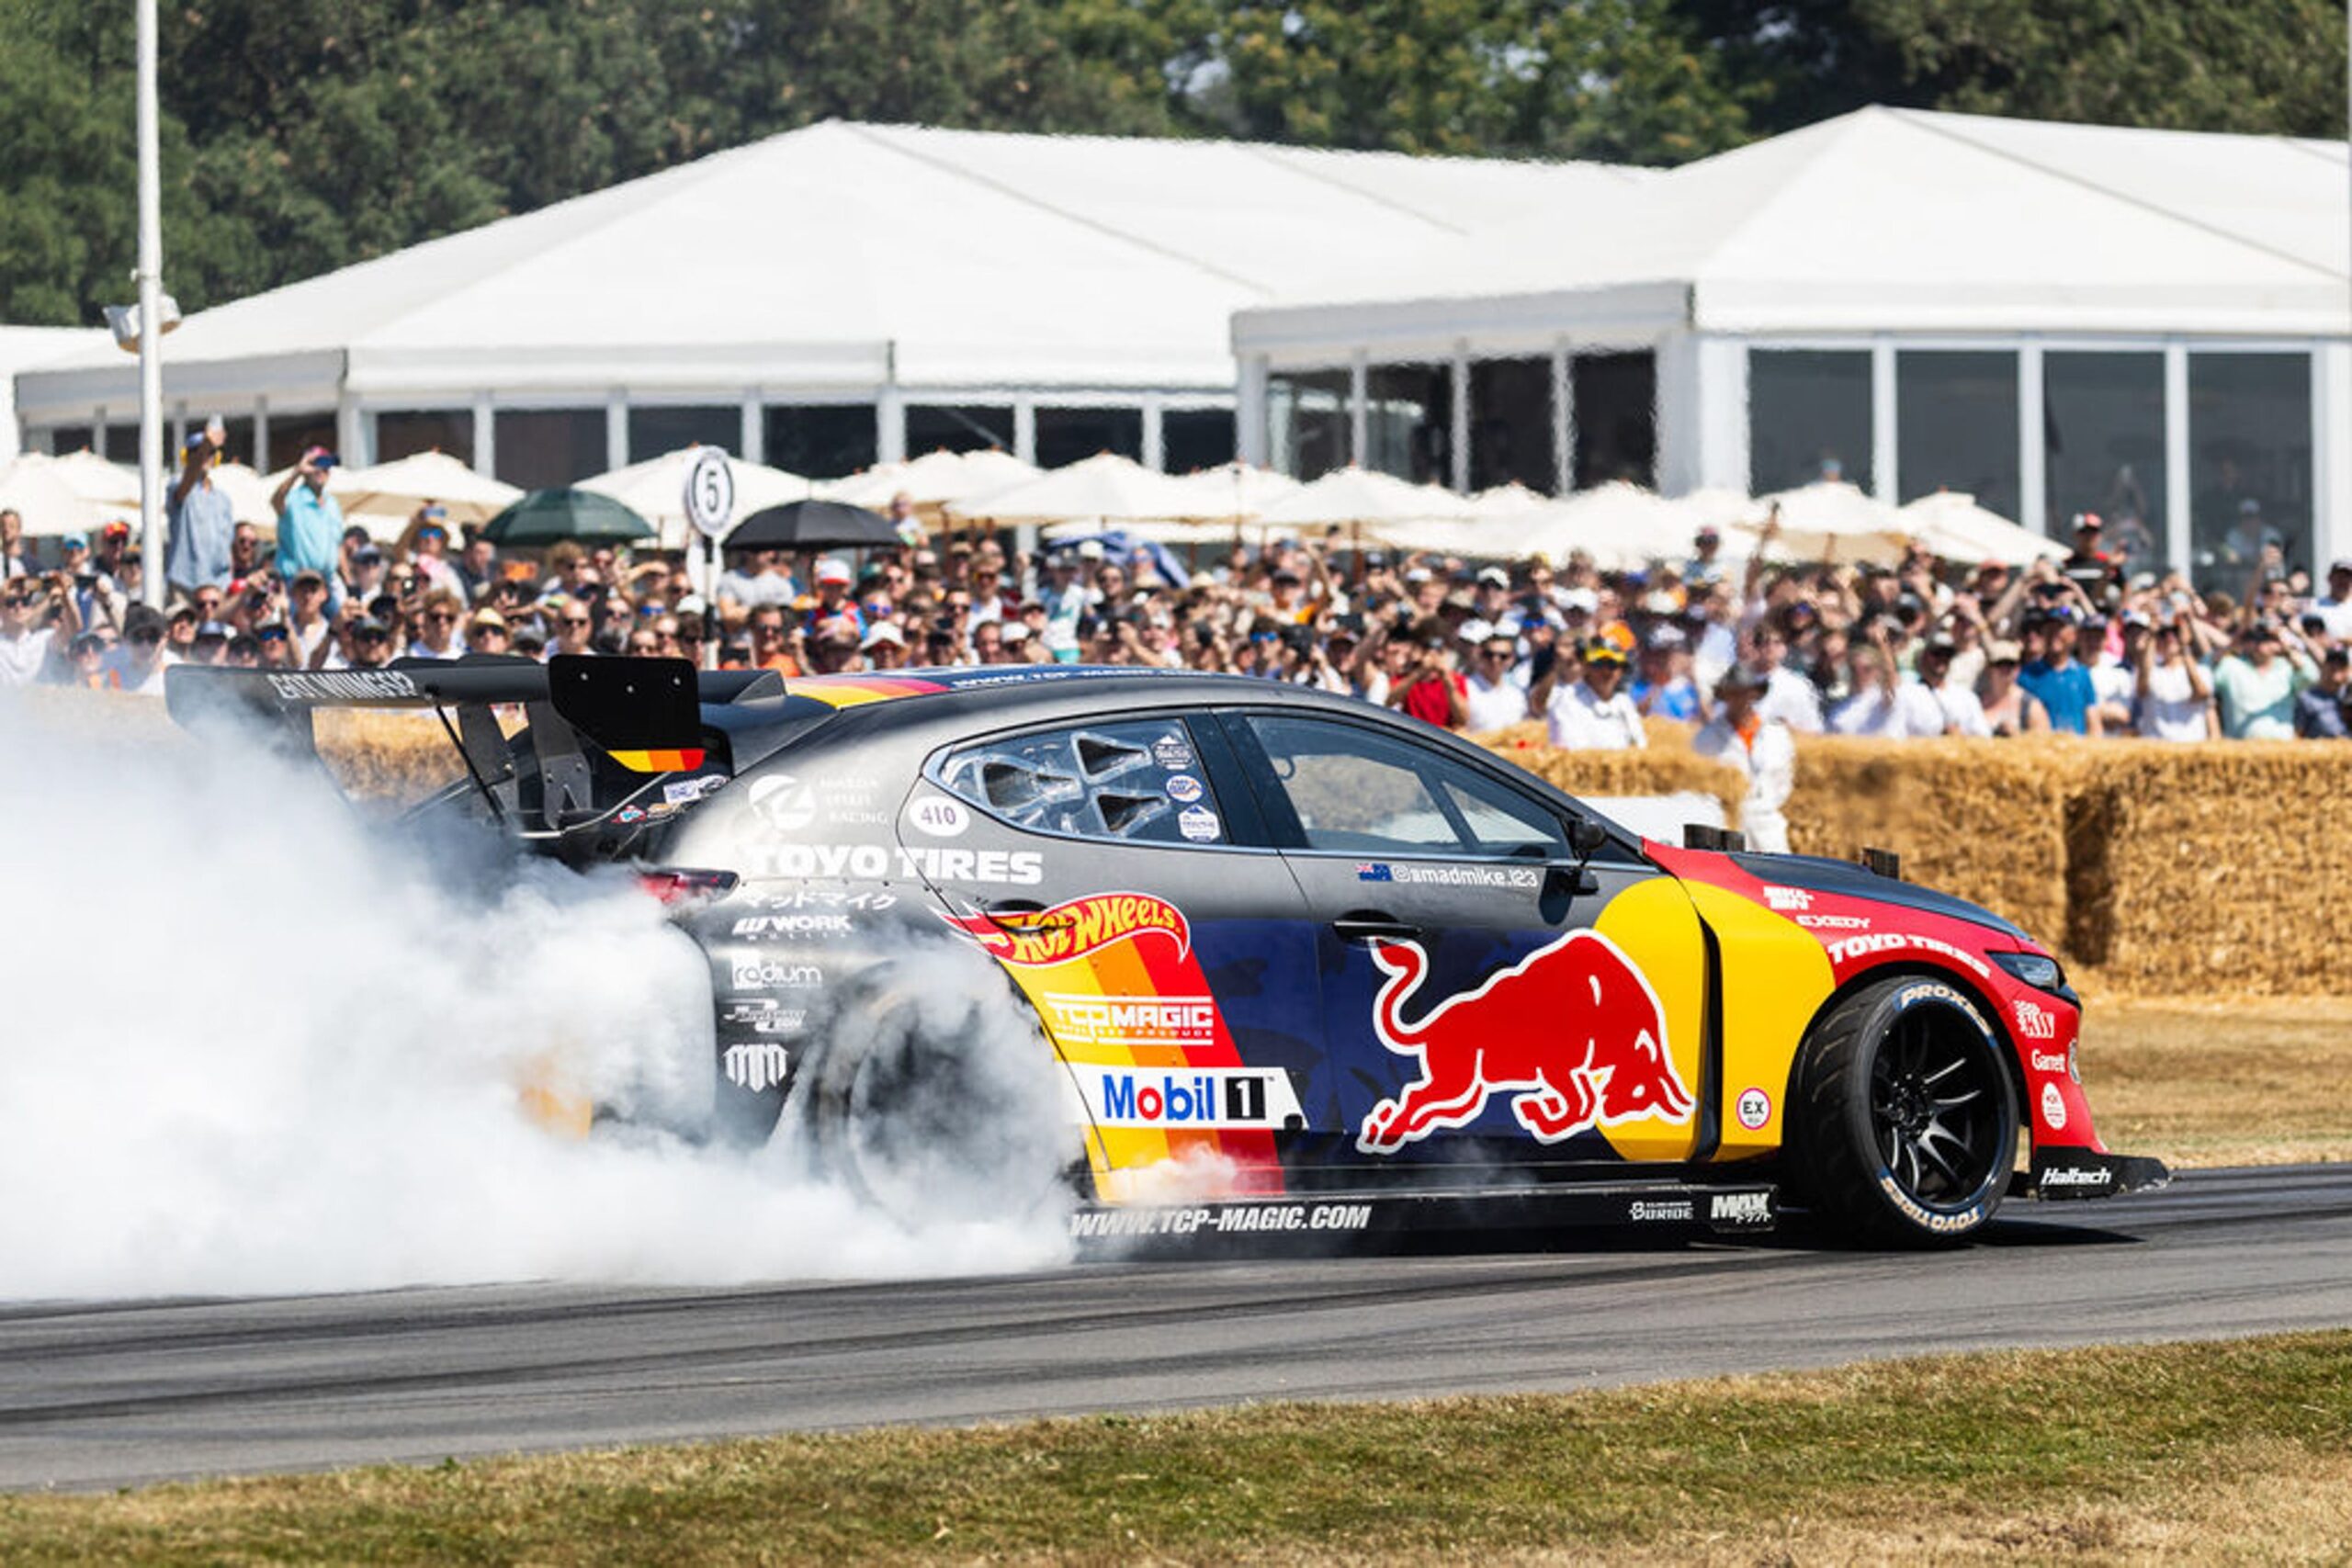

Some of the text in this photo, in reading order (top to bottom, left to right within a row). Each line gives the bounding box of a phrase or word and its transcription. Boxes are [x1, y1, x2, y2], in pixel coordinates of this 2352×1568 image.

[707, 469, 718, 513] 5
[920, 806, 957, 827] 410
[744, 844, 1043, 885] TOYO TIRES
[773, 915, 853, 931] WORK
[1827, 933, 1991, 979] TOYO TIRES
[1102, 1074, 1216, 1121] Mobil
[2040, 1166, 2112, 1185] Haltech
[1069, 1204, 1372, 1236] WWW.TCP-MAGIC.COM
[1710, 1193, 1770, 1219] MAX
